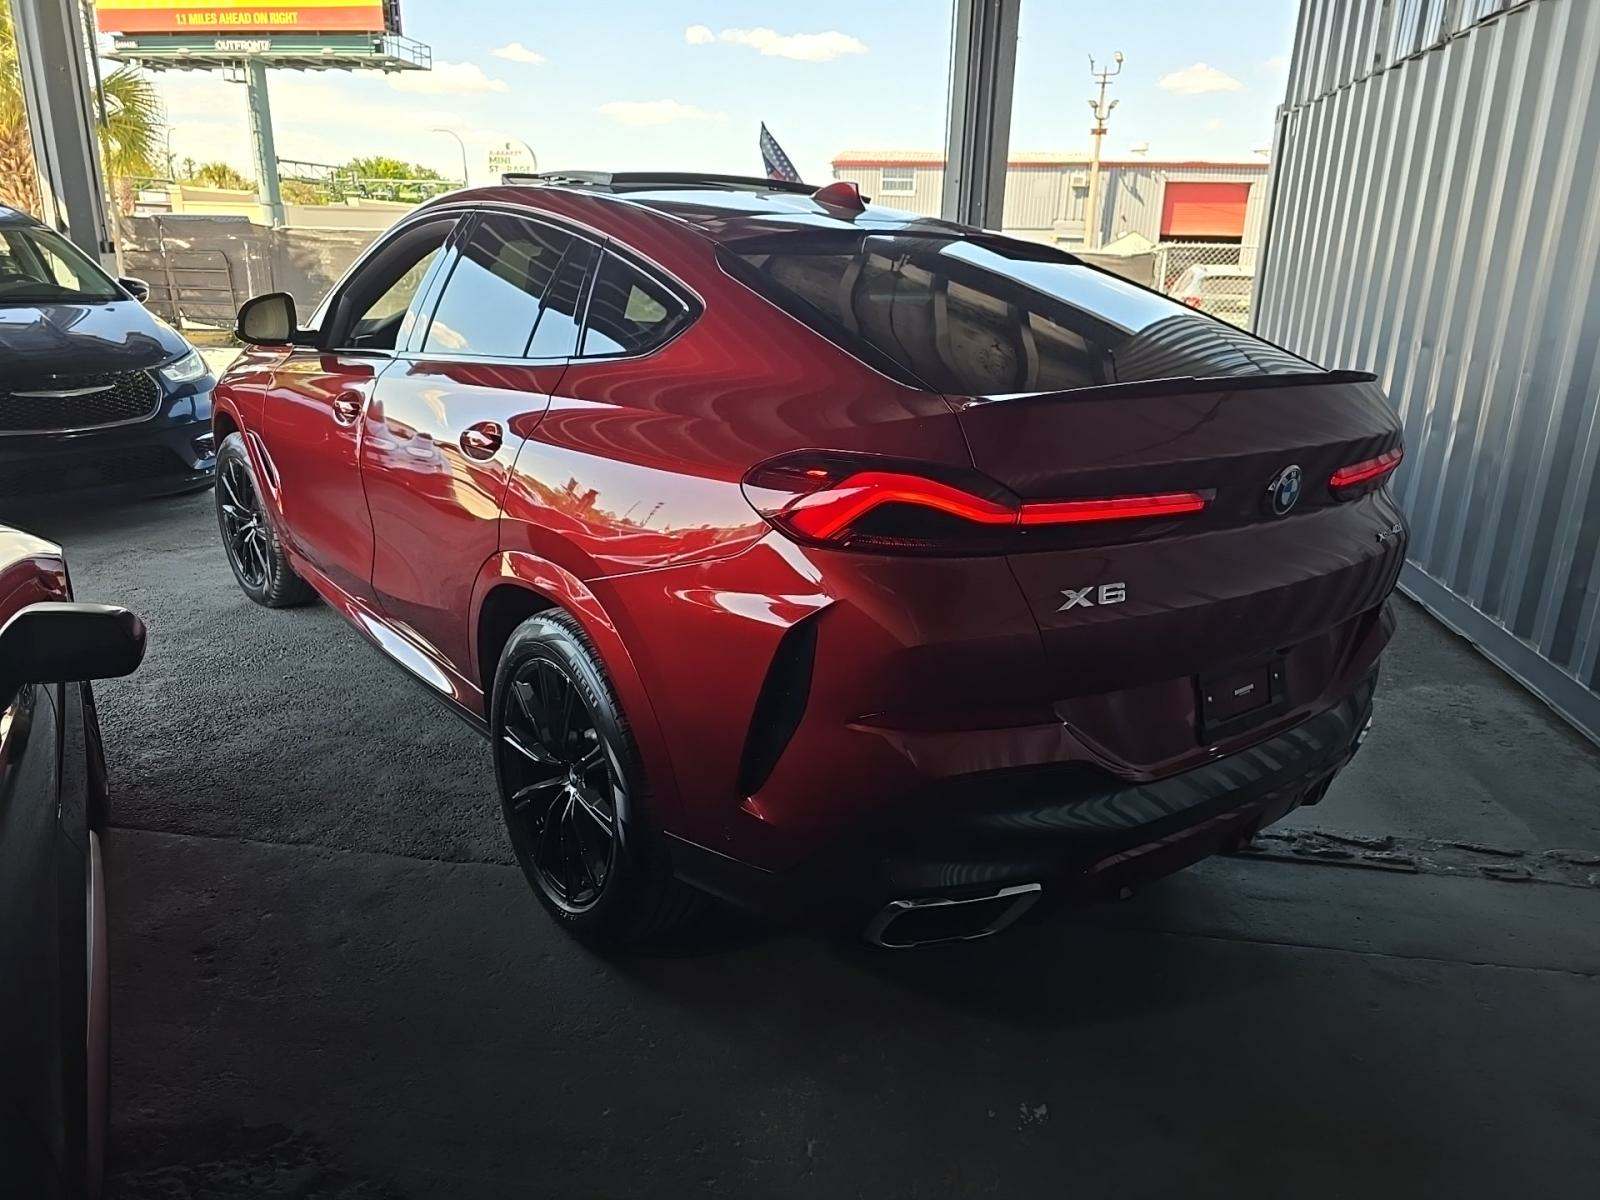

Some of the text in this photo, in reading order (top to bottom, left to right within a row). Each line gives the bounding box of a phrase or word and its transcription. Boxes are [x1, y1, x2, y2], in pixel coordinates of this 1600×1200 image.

[188, 13, 217, 25] MILES
[219, 12, 252, 25] AHEAD
[253, 12, 270, 25] ON
[270, 12, 298, 25] RIGHT
[489, 156, 511, 164] MINI
[489, 165, 531, 173] STRAGE
[1056, 582, 1126, 612] X6
